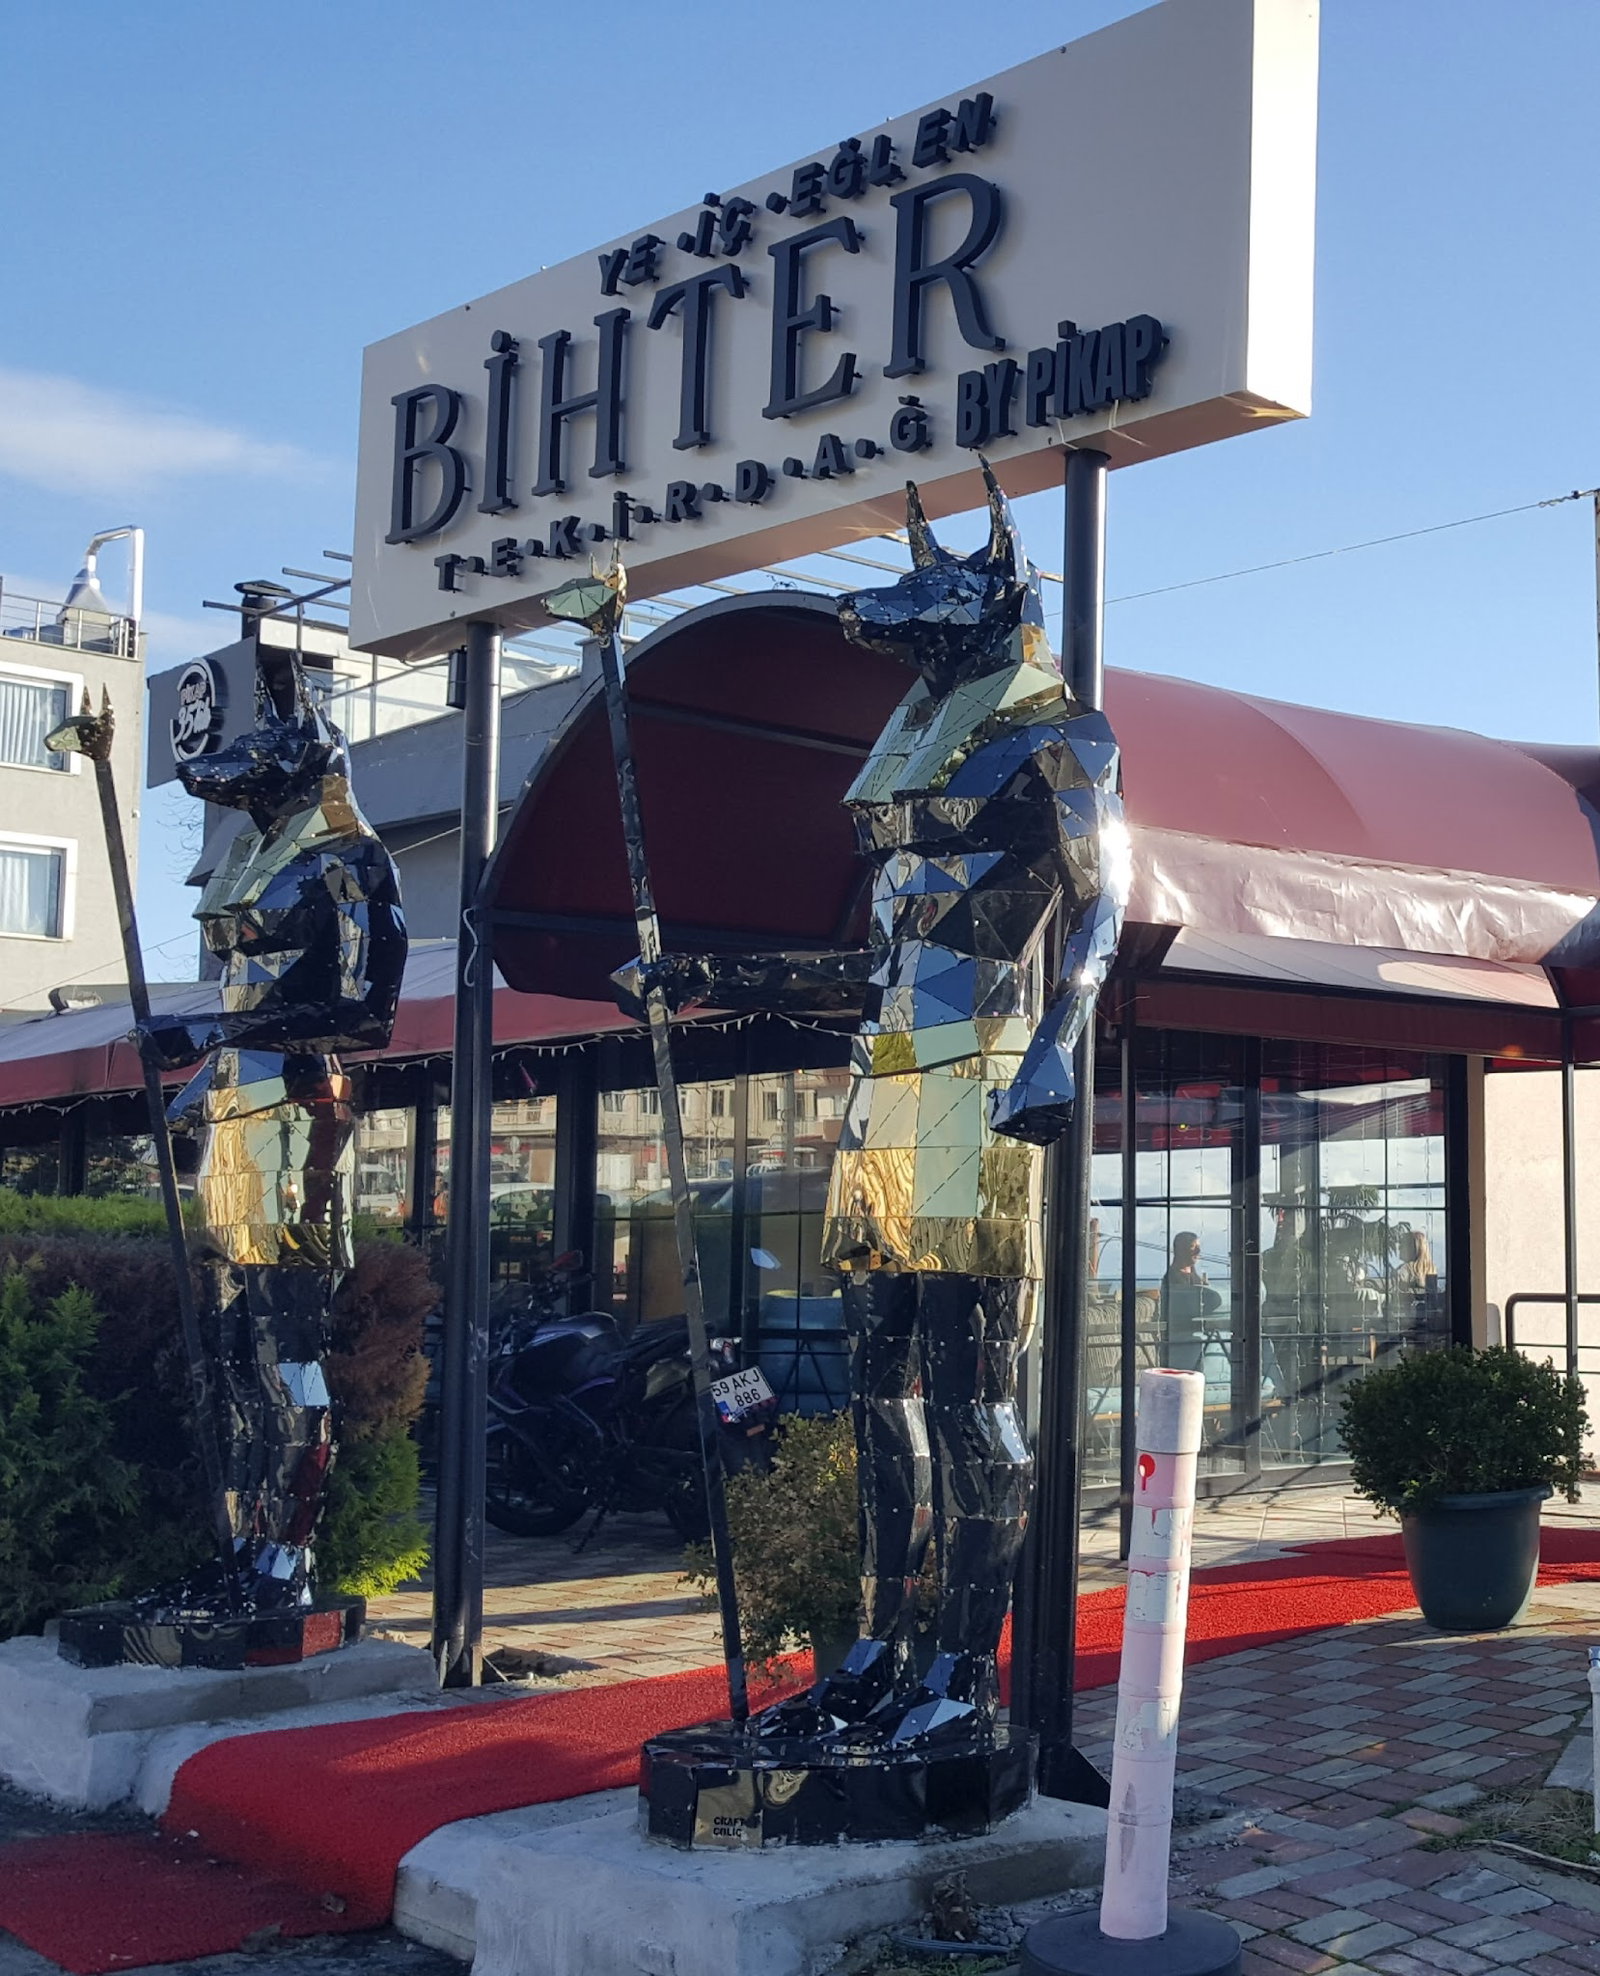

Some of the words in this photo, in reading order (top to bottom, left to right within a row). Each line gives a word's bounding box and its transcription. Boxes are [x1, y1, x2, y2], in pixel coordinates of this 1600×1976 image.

[598, 234, 661, 297] YE
[789, 91, 995, 219] EĞLEN
[385, 172, 1006, 546] BİHTER
[956, 358, 1018, 449] BY
[1026, 314, 1165, 428] PİKAP
[712, 1381, 730, 1397] 59
[732, 1369, 760, 1390] AKJ
[734, 1388, 761, 1407] 886
